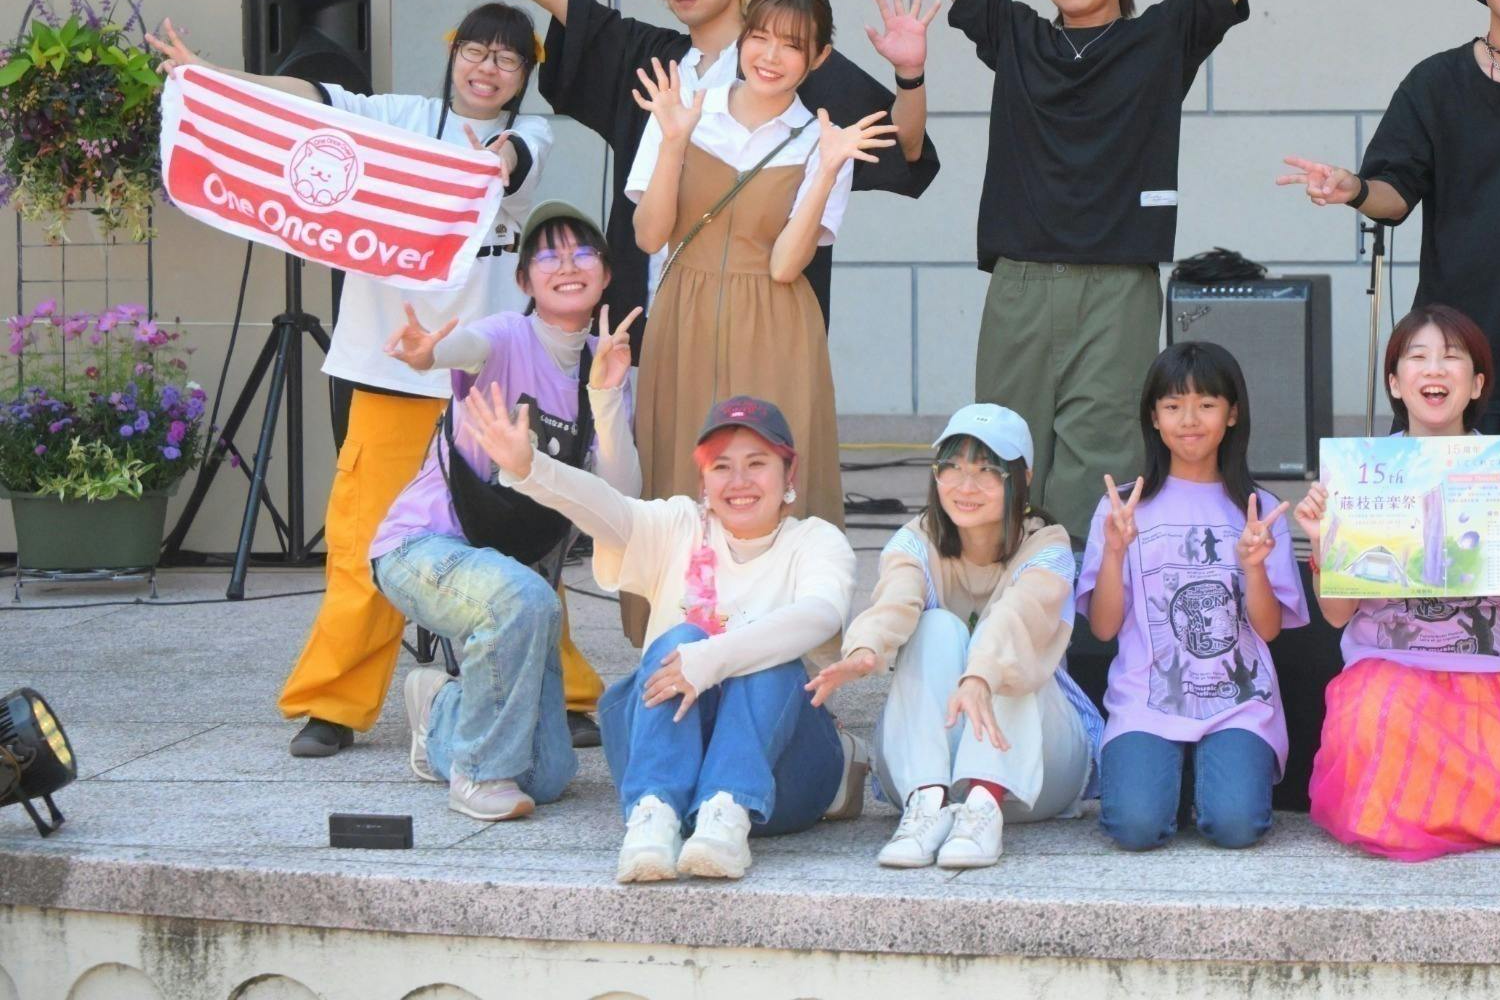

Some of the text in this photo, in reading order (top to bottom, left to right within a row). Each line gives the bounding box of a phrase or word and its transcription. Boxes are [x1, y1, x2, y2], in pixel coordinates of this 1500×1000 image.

[203, 173, 433, 271] One Once Over
[1358, 462, 1403, 484] 15th
[1340, 495, 1416, 511] 藤枝音楽祭
